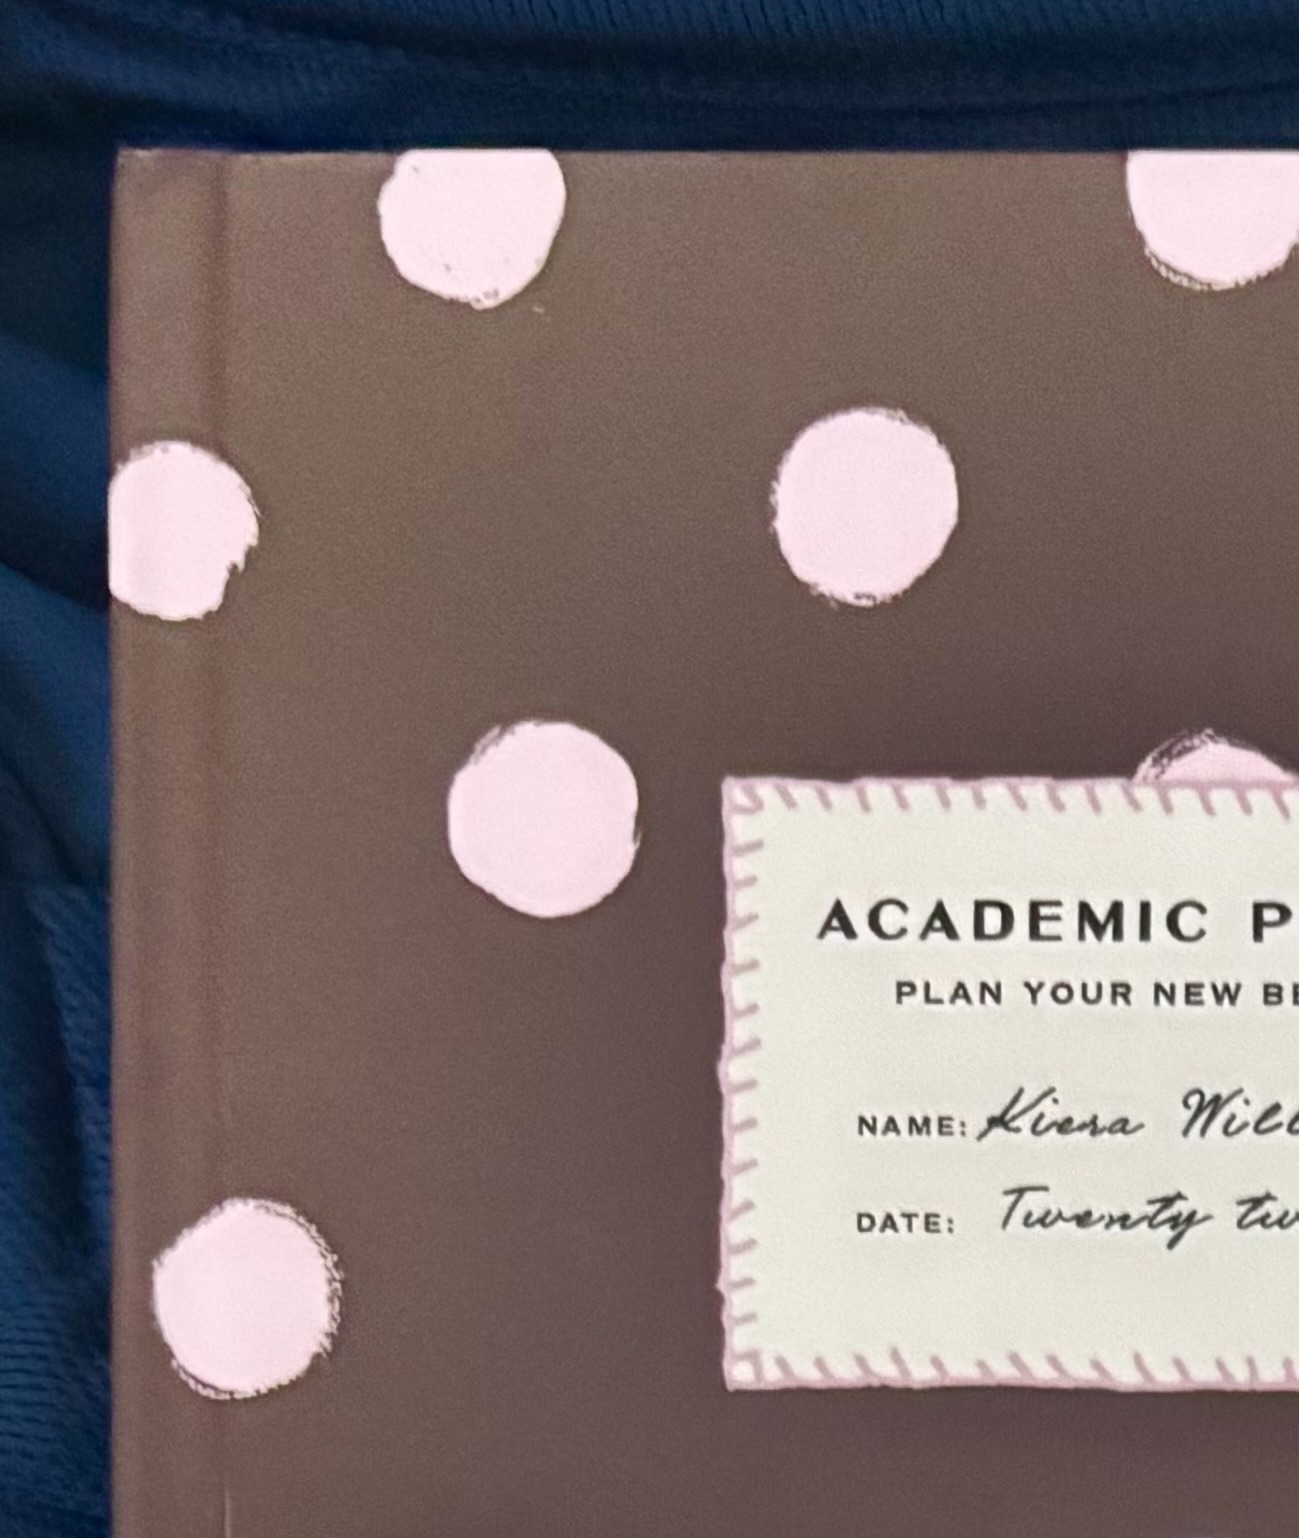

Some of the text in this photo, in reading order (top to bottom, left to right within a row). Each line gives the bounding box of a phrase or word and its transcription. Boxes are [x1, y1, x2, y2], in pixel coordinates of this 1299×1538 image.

[818, 898, 1208, 942] ACADEMIC
[895, 981, 1003, 1005] PLAN
[1025, 980, 1133, 1006] YOUR
[1154, 981, 1242, 1006] NEW
[858, 1114, 967, 1137] NAME:
[976, 1086, 1145, 1141] Kiera
[857, 1211, 955, 1234] DATE:
[1000, 1185, 1213, 1250] Twenty
